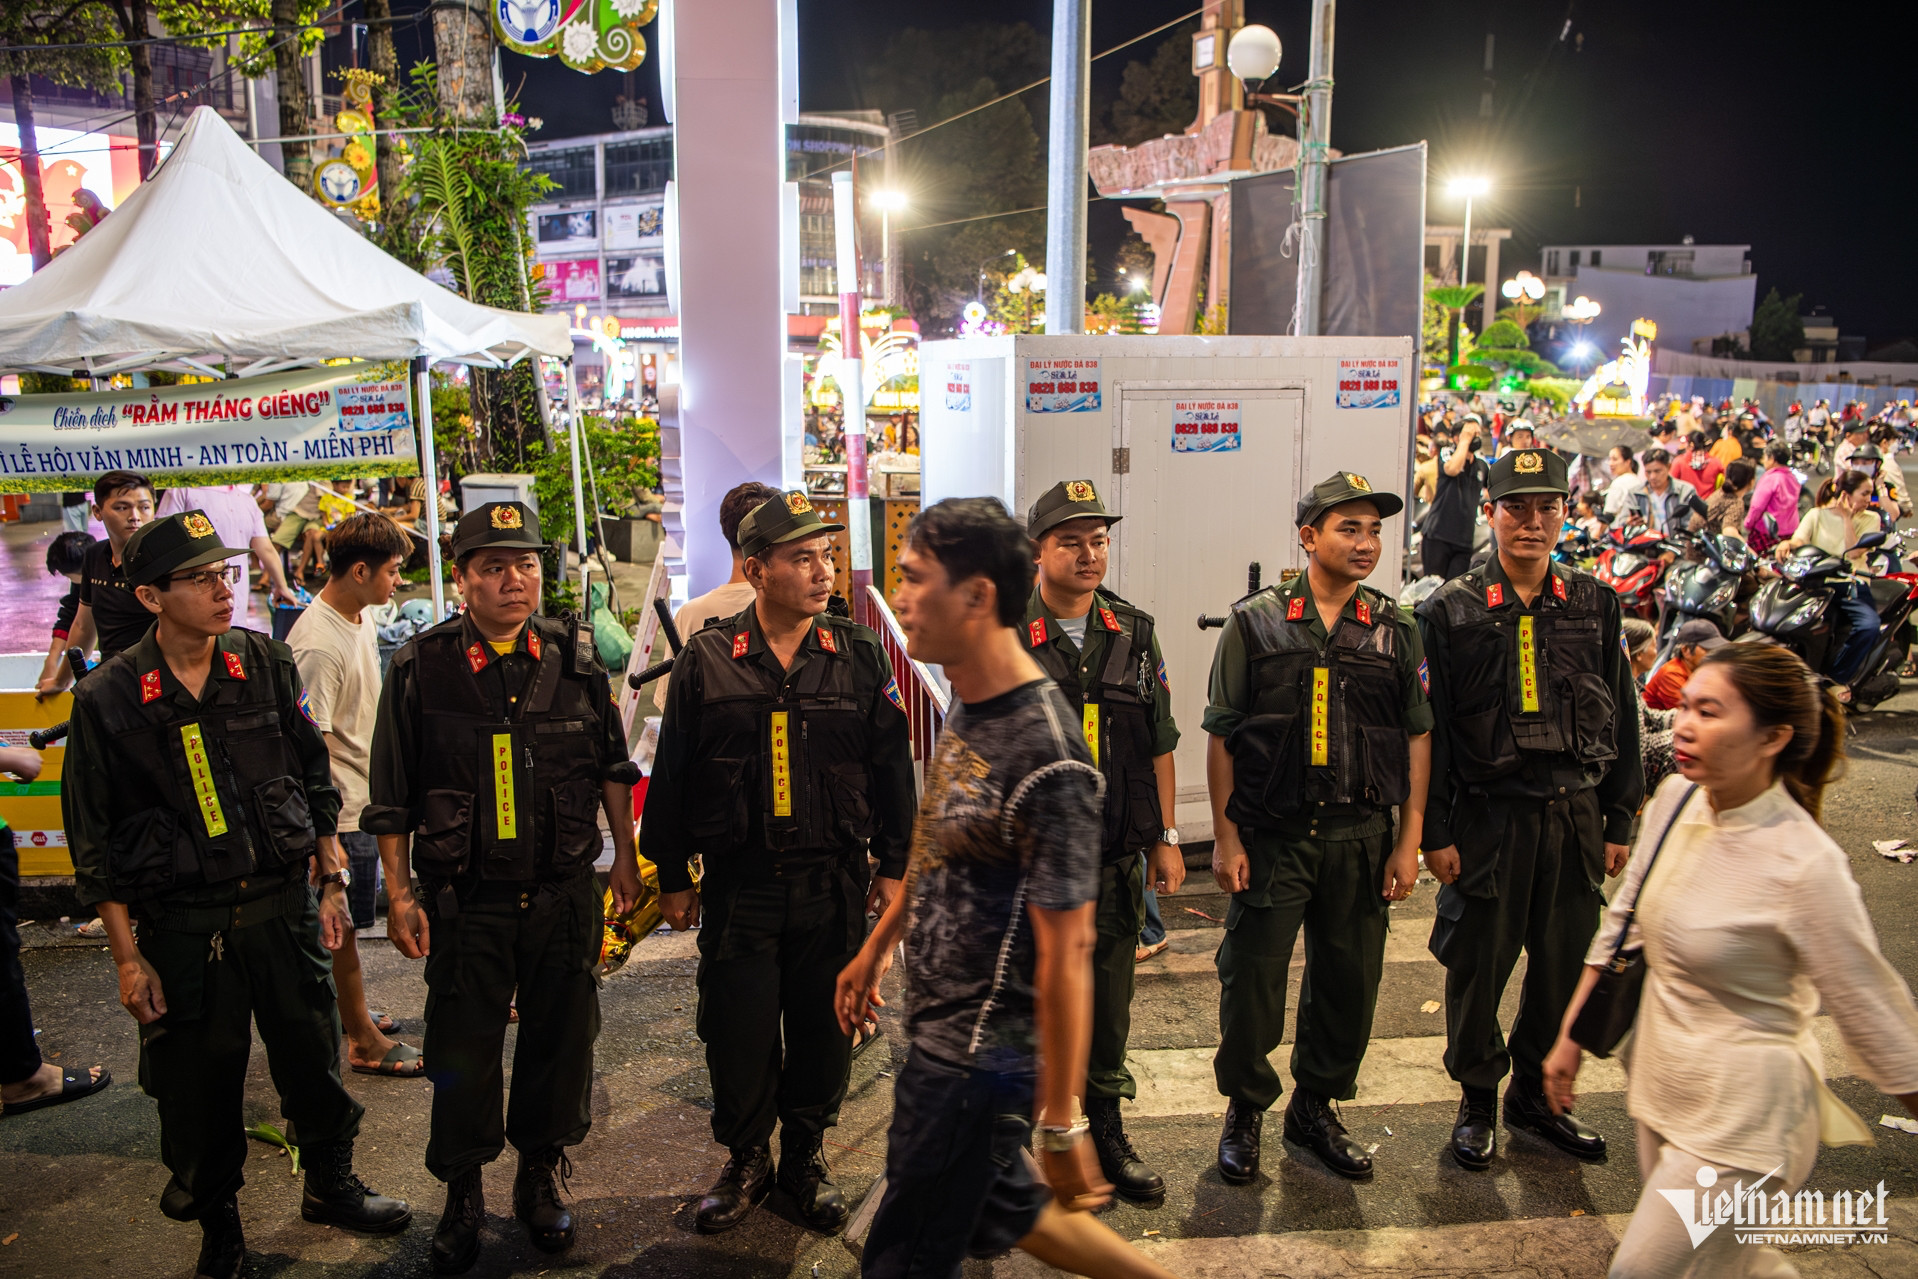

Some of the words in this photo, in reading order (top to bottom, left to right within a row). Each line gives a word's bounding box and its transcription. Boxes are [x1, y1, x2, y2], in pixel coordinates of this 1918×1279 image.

[1085, 360, 1098, 369] 838
[53, 406, 88, 430] Chiến
[89, 405, 118, 431] dịch
[184, 394, 252, 423] THÁNG
[10, 443, 36, 473] LỄ
[37, 446, 76, 478] HỘI
[76, 445, 122, 471] VĂN
[125, 446, 183, 469] MINH
[199, 445, 227, 466] AN
[231, 436, 287, 464] TOÀN
[304, 427, 355, 460] MIỄN
[359, 429, 394, 456] PHÍ
[1522, 629, 1533, 699] POLICE
[1315, 680, 1324, 751] POLICE
[189, 738, 218, 823] POLICE
[499, 746, 510, 826] POLICE
[775, 725, 786, 801] POLICE
